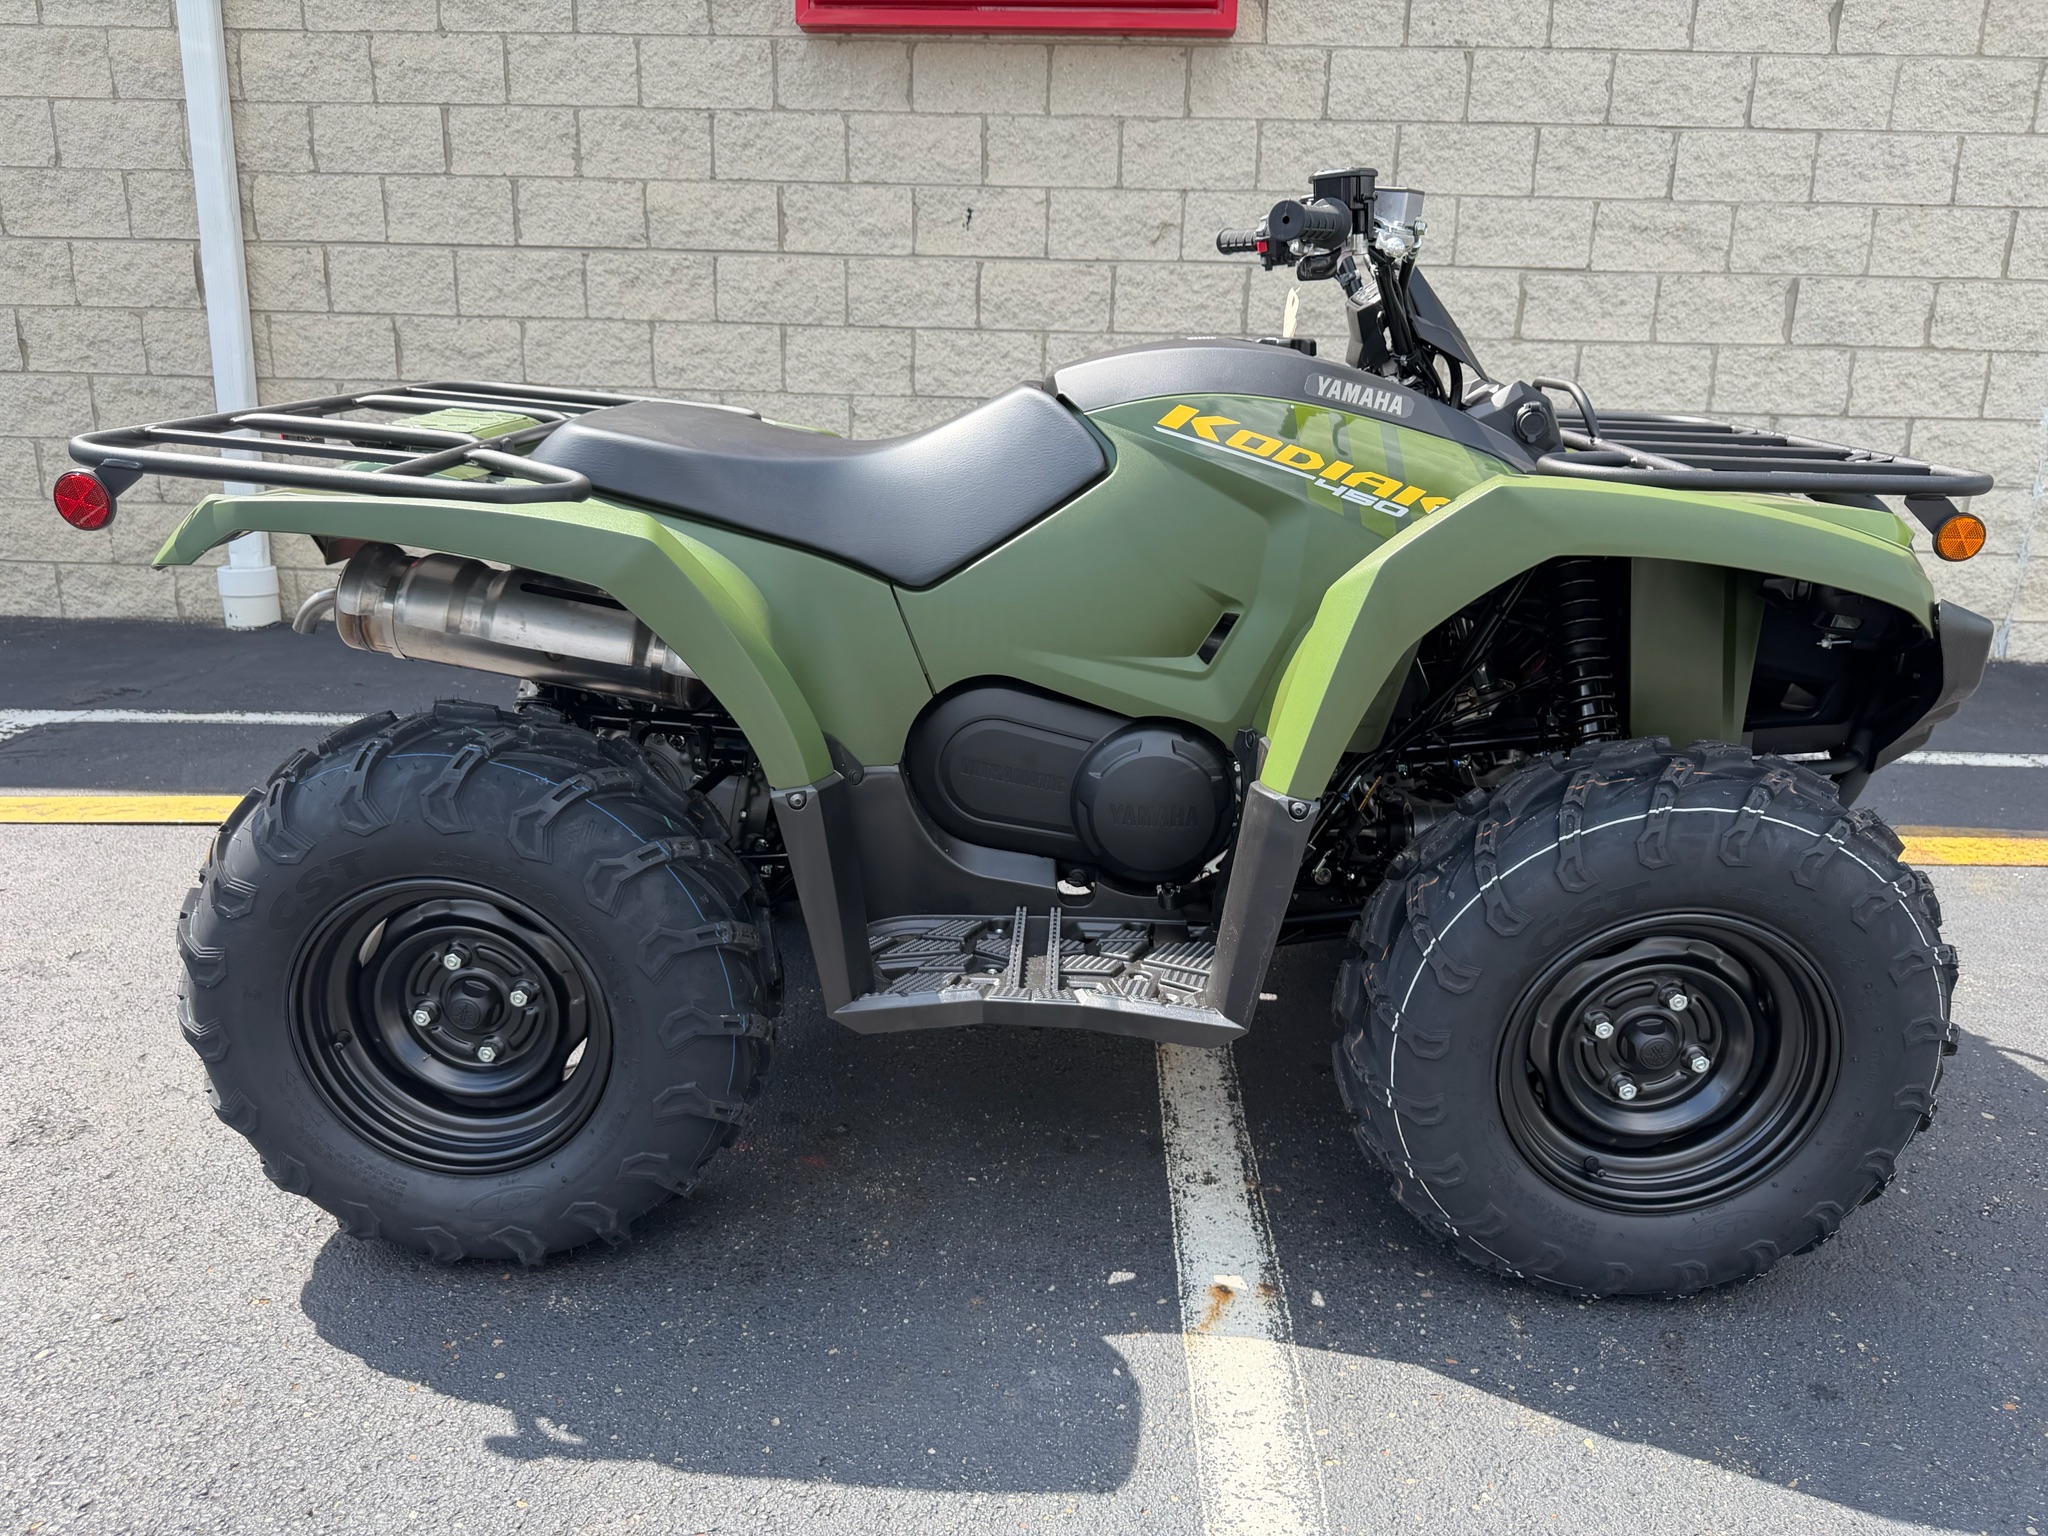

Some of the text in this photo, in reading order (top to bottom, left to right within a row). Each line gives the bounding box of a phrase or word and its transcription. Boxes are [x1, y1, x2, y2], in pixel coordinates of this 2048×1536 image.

[1317, 374, 1404, 415] YAMAHA
[1157, 404, 1451, 514] KODIAK
[1314, 478, 1409, 518] 450
[1109, 803, 1200, 828] YAMAHA
[267, 846, 367, 932] CST
[1525, 879, 1651, 961] CST
